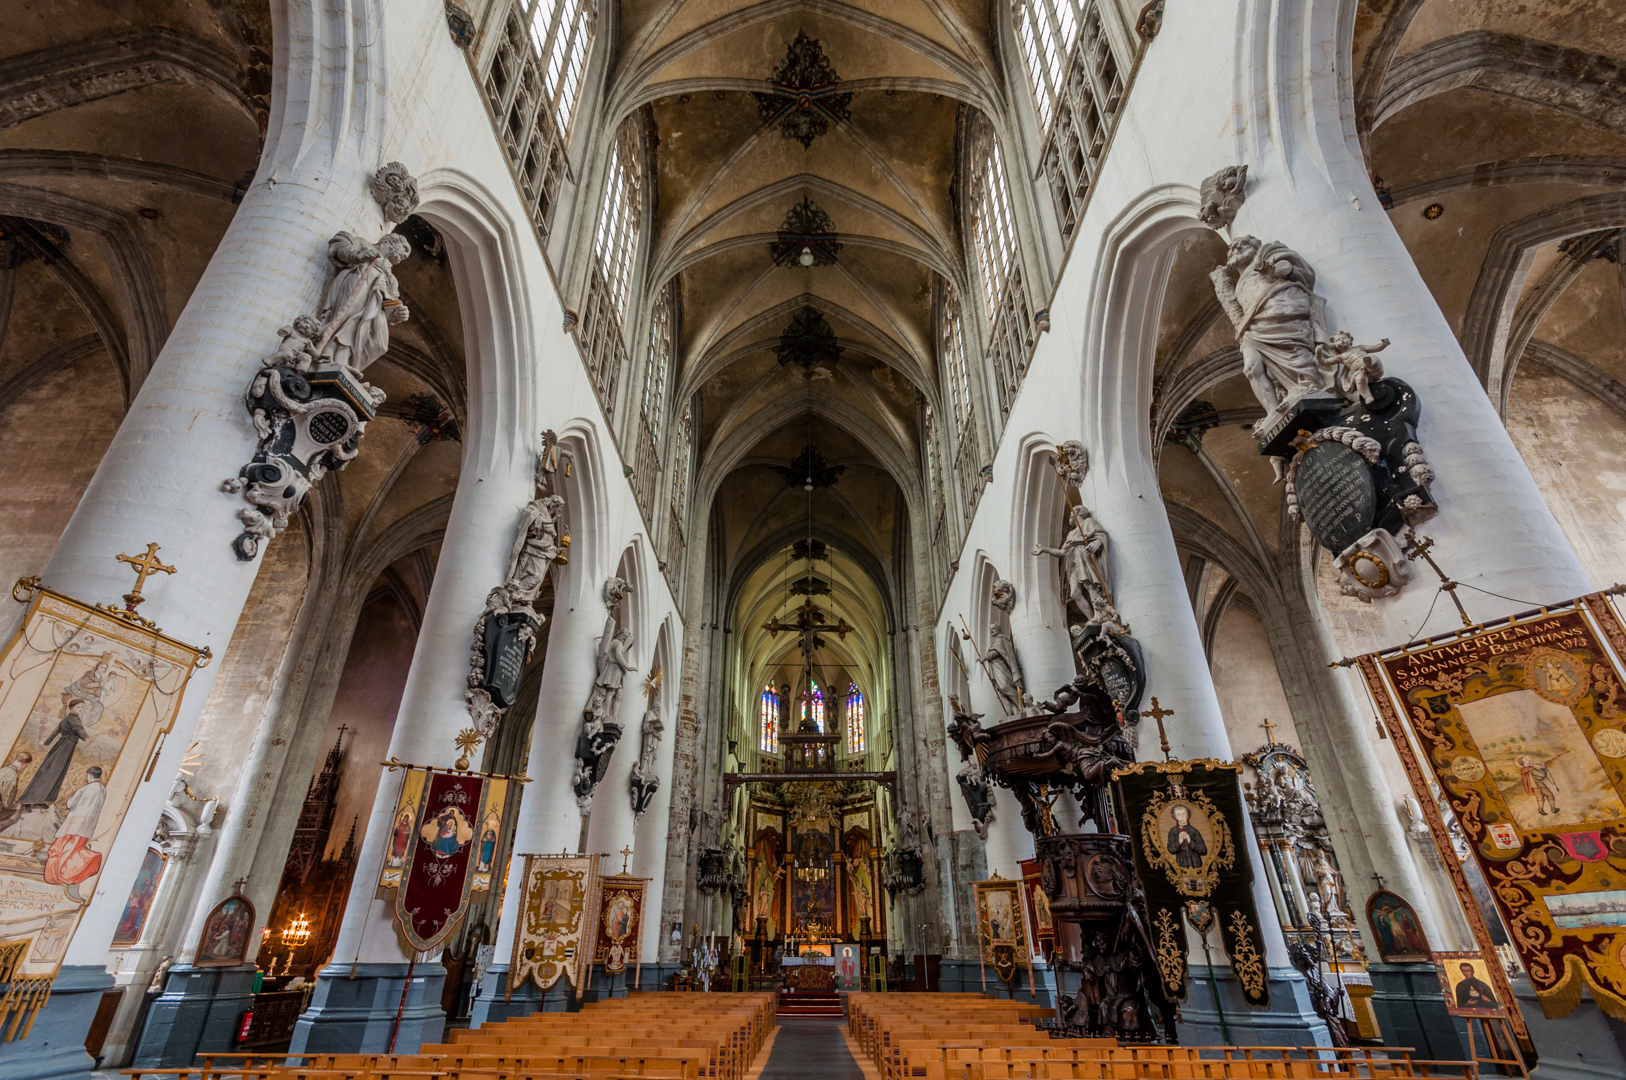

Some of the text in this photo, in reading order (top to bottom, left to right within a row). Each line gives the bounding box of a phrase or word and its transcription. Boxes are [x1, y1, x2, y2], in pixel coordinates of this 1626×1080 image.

[1408, 620, 1560, 666] ANTWERPEN AAN
[1489, 628, 1583, 654] BERCHMANS
[1400, 676, 1426, 692] 1888
